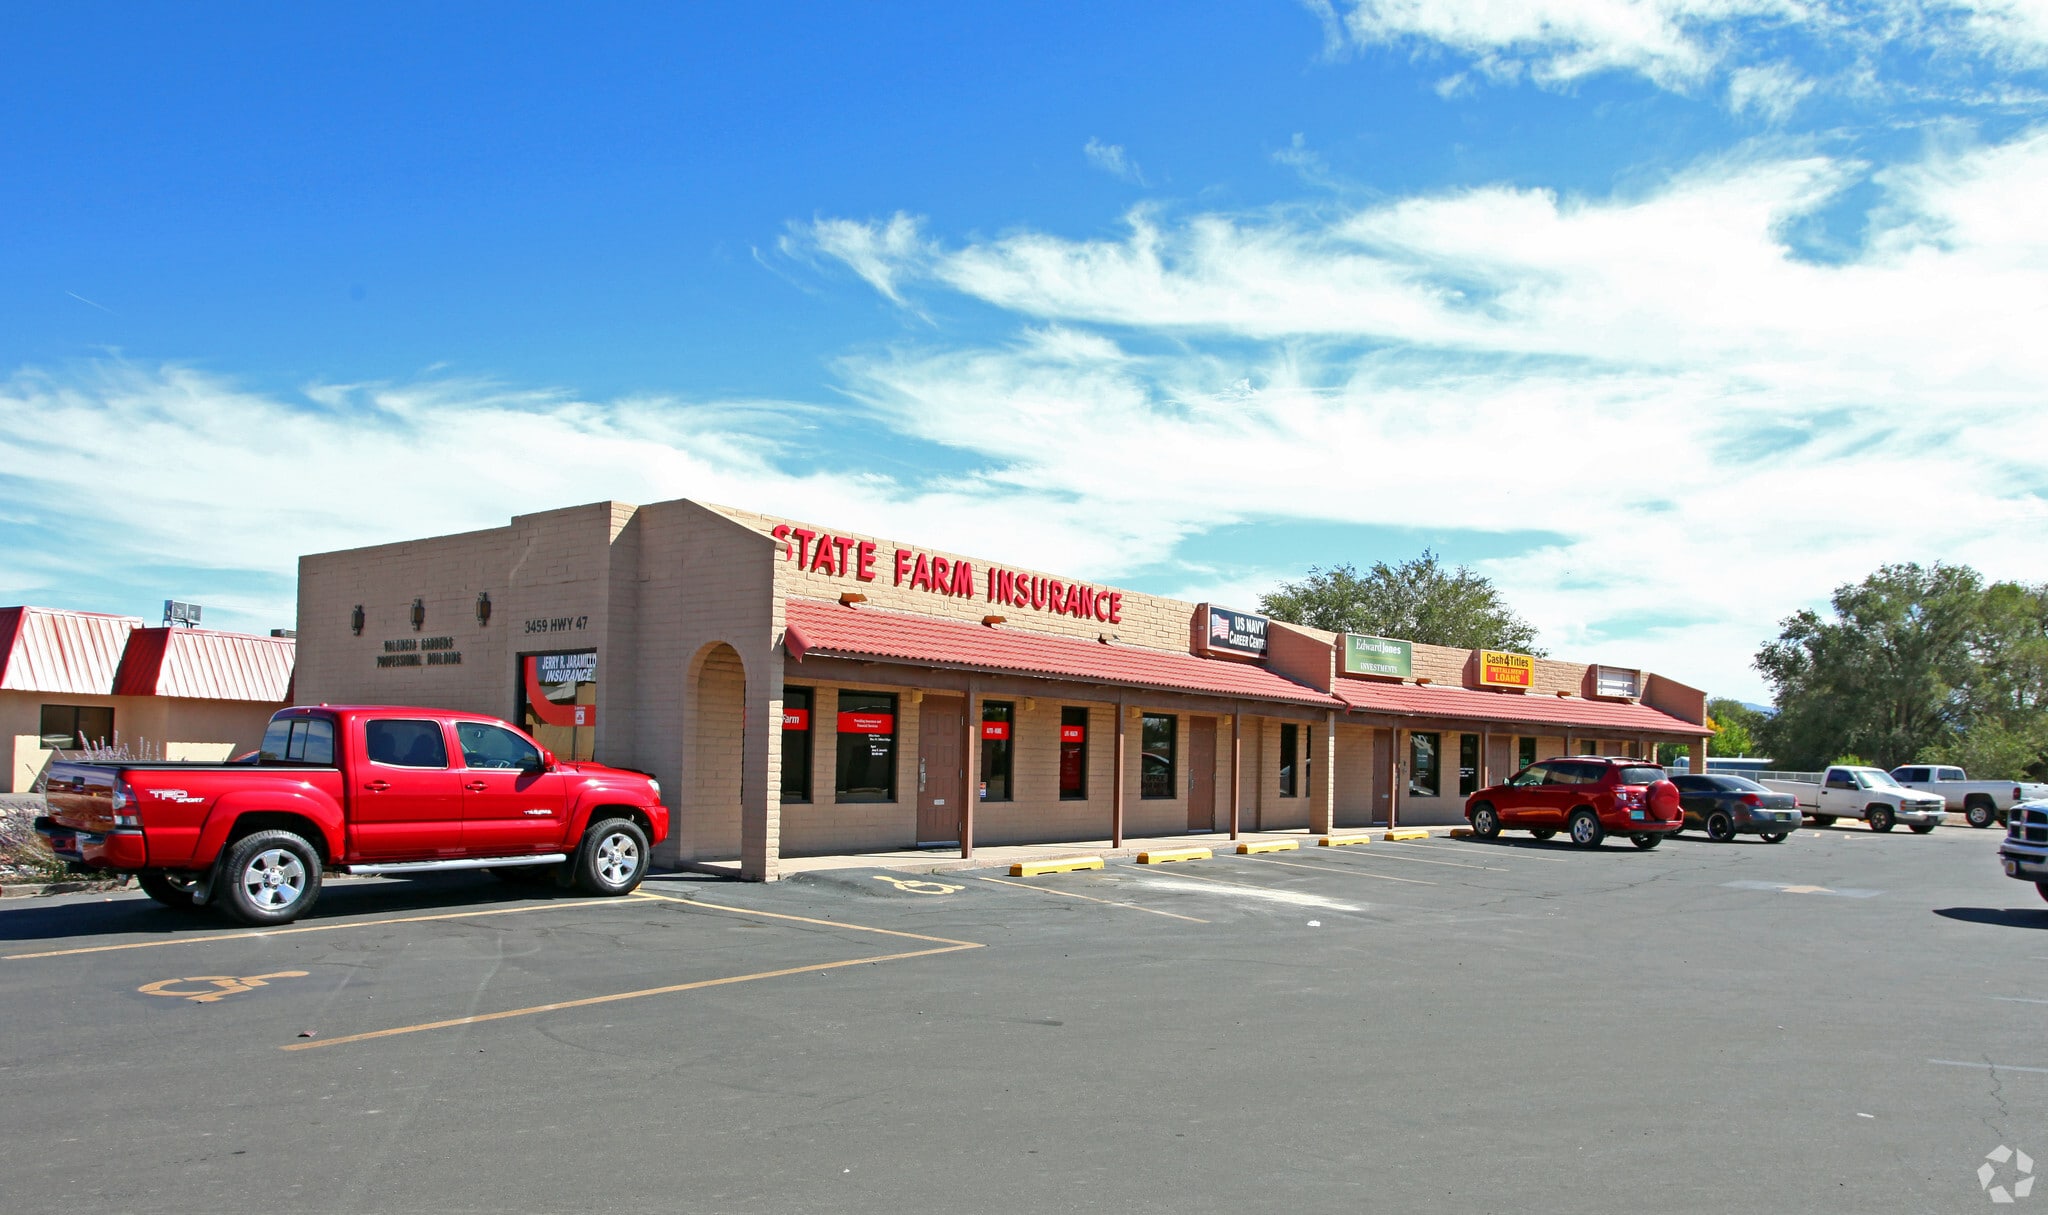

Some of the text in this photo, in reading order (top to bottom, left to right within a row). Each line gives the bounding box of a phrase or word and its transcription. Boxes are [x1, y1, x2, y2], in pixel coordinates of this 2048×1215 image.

[771, 524, 1123, 624] STATE FARM INSURANCE
[524, 615, 589, 634] 3459 HWY 47
[1234, 615, 1265, 636] US NAVY
[1228, 630, 1249, 647] CAREER
[542, 655, 560, 670] JERRY
[566, 652, 597, 669] JARAMILLO
[1360, 662, 1398, 674] INVESTMENTS
[545, 668, 593, 683] INSURANCE
[1495, 673, 1521, 684] LOANS
[145, 788, 188, 800] TRD
